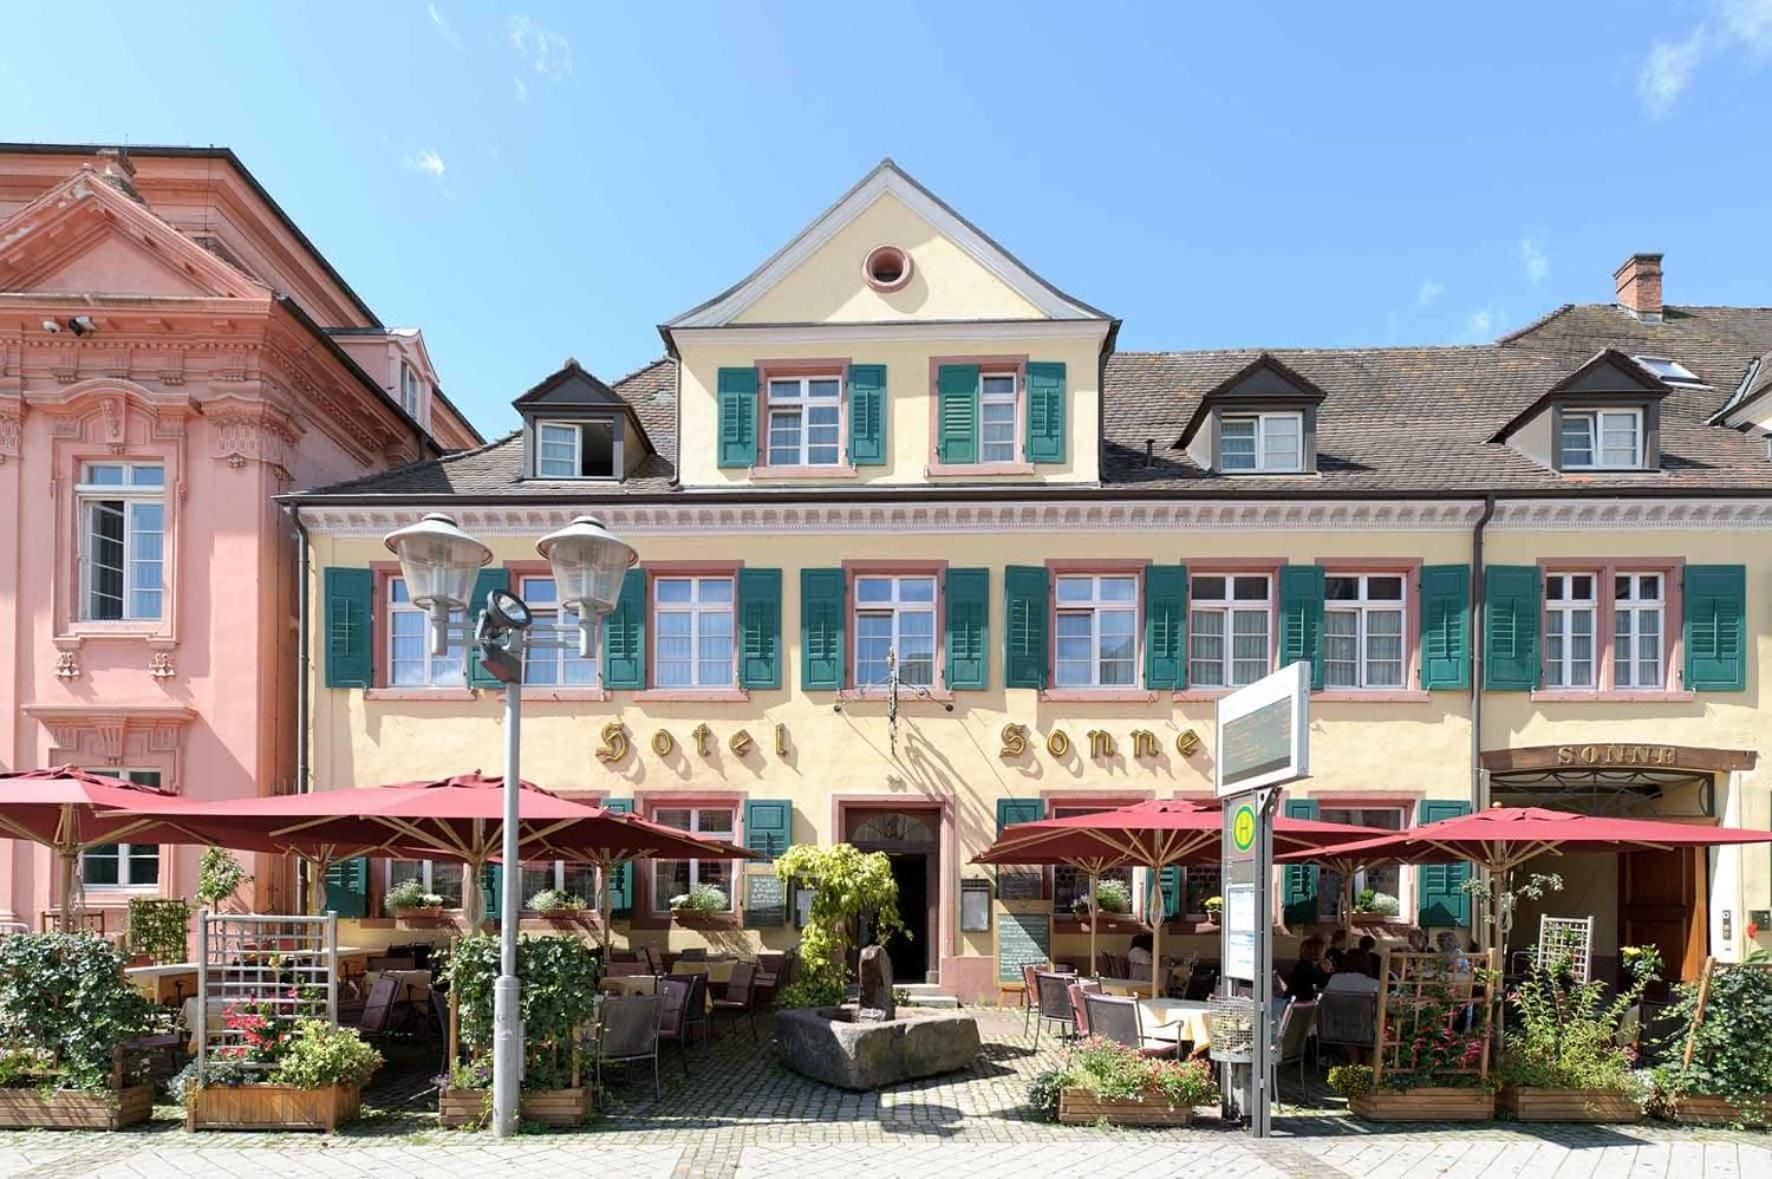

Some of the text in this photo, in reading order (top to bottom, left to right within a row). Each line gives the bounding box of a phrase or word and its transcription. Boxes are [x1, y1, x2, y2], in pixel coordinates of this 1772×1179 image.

[595, 722, 786, 763] Hotel
[1000, 722, 1200, 758] Sonne
[1558, 746, 1676, 765] SONNE
